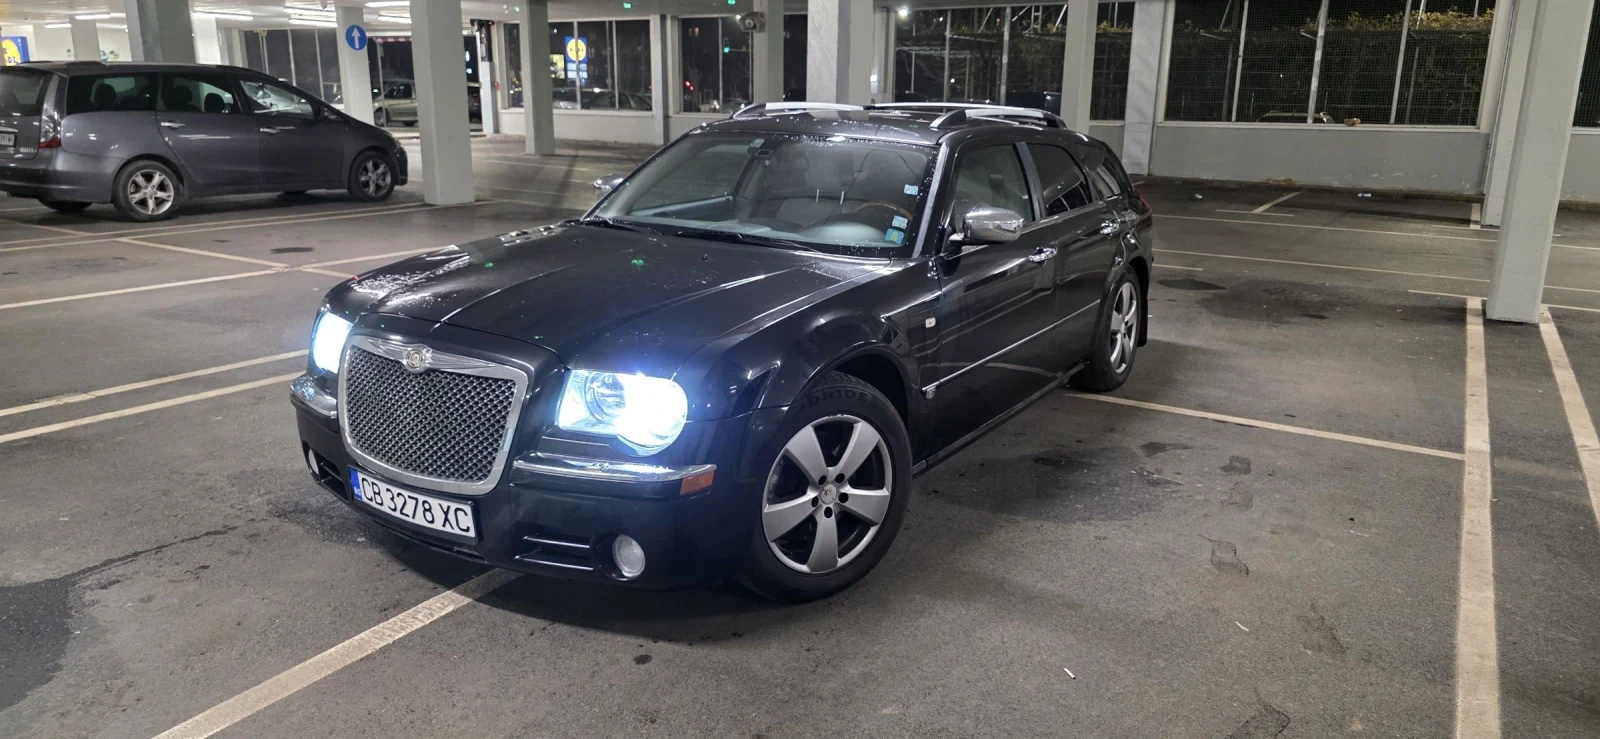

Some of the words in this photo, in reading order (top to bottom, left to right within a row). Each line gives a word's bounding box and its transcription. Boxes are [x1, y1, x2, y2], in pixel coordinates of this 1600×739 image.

[361, 477, 384, 506] CB
[386, 487, 435, 525] 3278
[438, 502, 471, 533] XC
